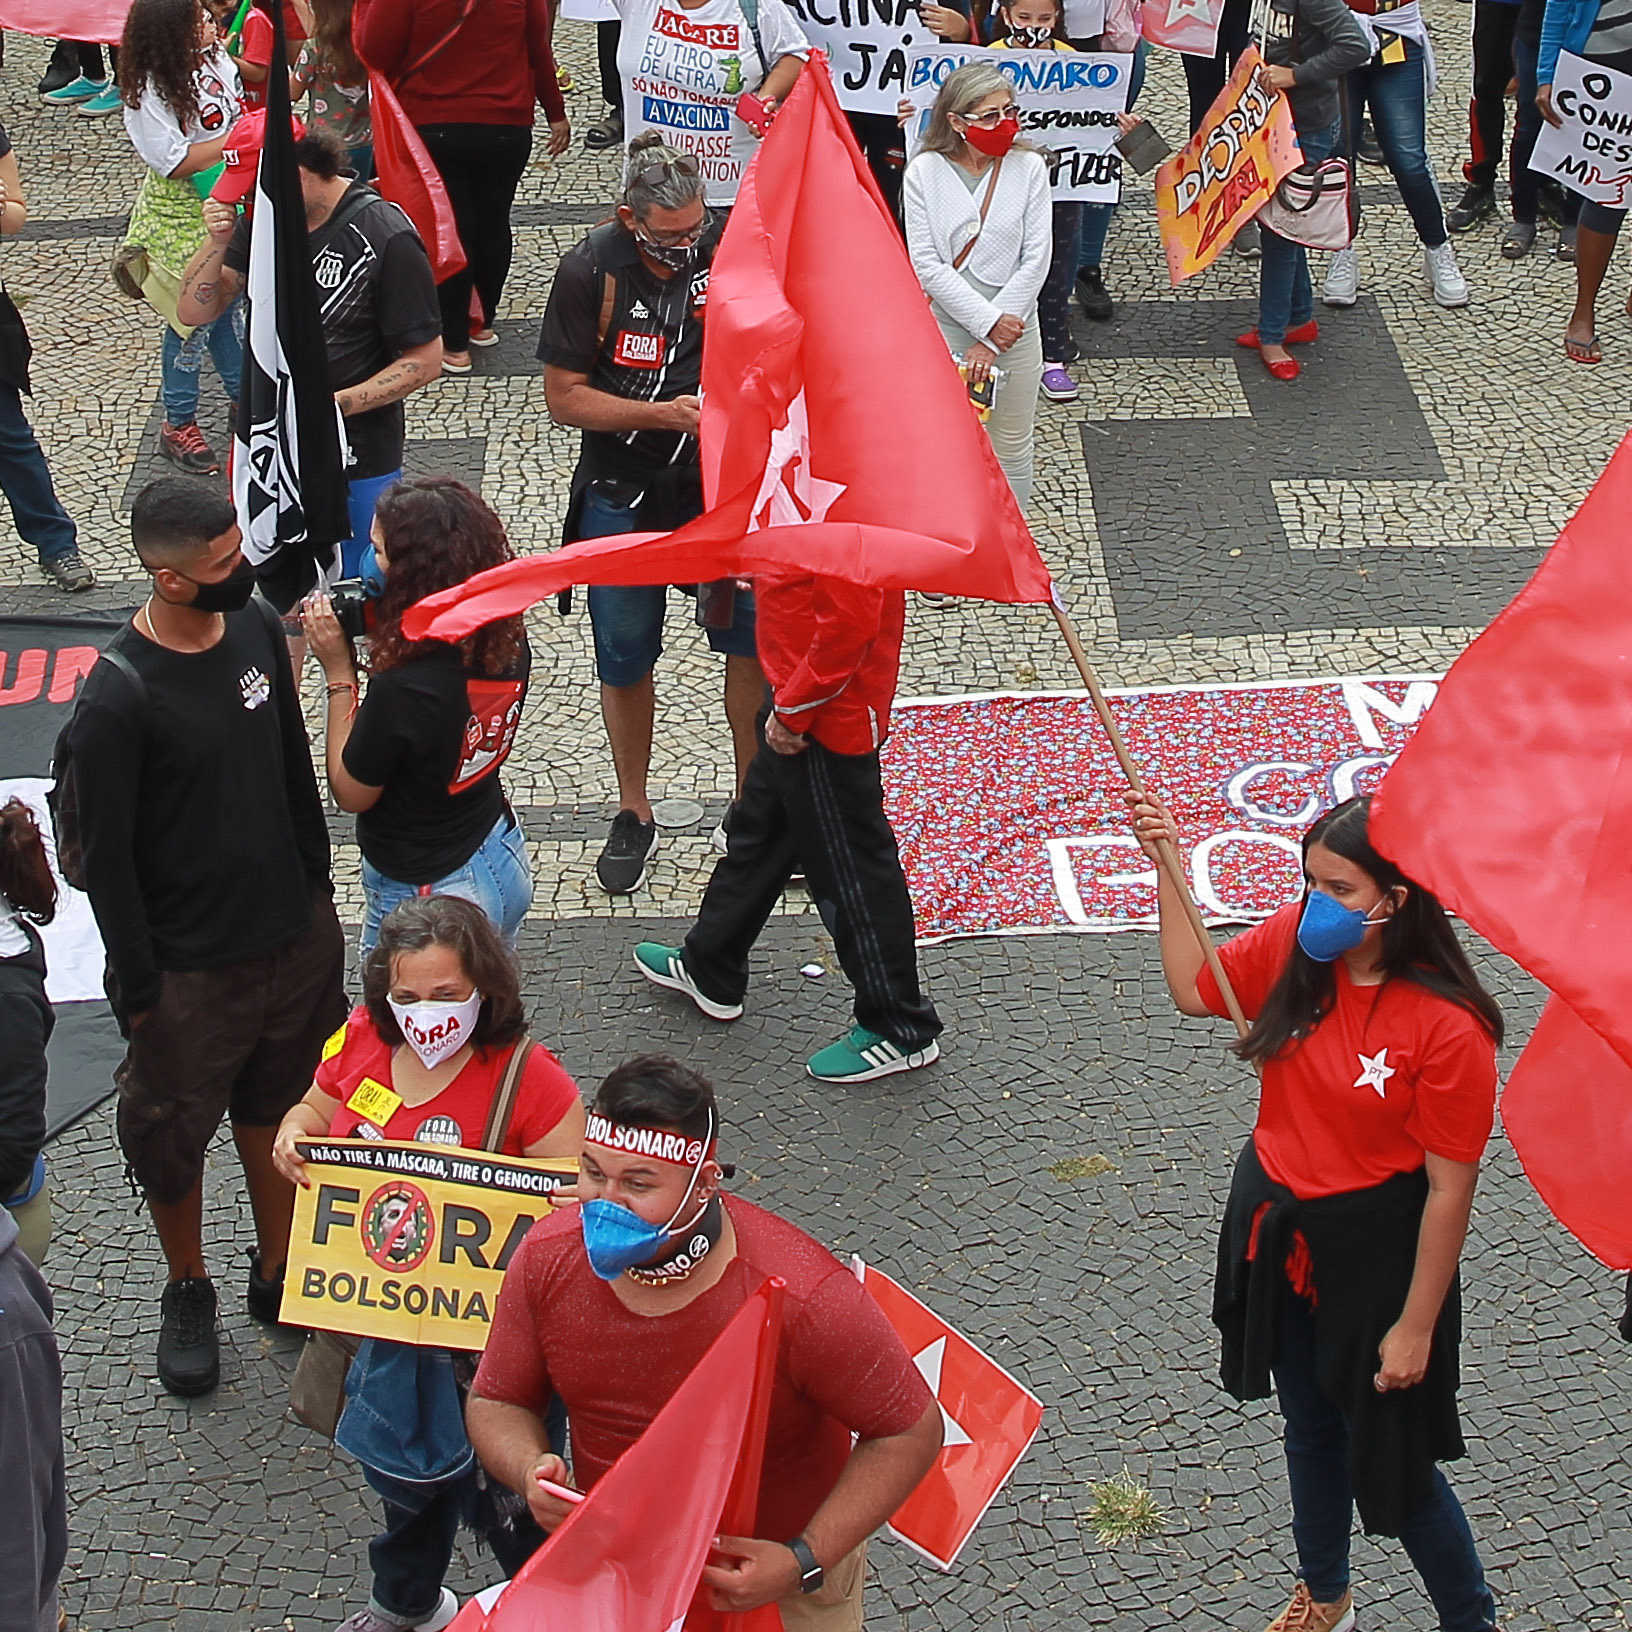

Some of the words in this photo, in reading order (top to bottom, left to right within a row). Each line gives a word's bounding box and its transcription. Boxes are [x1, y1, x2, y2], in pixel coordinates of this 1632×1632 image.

[653, 9, 741, 49] JACARÉ
[646, 35, 669, 57] EU
[671, 39, 714, 70] TIRO
[843, 40, 906, 95] JÁ
[631, 74, 647, 92] SÓ
[648, 77, 679, 99] NÃO
[639, 55, 662, 78] DE
[664, 60, 723, 94] LETRA,
[1582, 72, 1612, 101] O
[648, 101, 662, 121] A
[664, 103, 726, 129] VACINA
[667, 132, 732, 159] VIRASSE
[624, 335, 658, 355] FORA
[404, 1014, 460, 1046] FORA
[1365, 1065, 1384, 1081] PT
[424, 1118, 455, 1134] FORA
[588, 1114, 686, 1162] BOLSONARO
[309, 1146, 338, 1164] NÃO
[339, 1149, 369, 1167] TIRE
[371, 1153, 383, 1168] A
[385, 1152, 448, 1178] MÁSCARA,
[449, 1161, 477, 1180] TIRE
[478, 1166, 490, 1182] O
[492, 1168, 563, 1194] GENOCIDA
